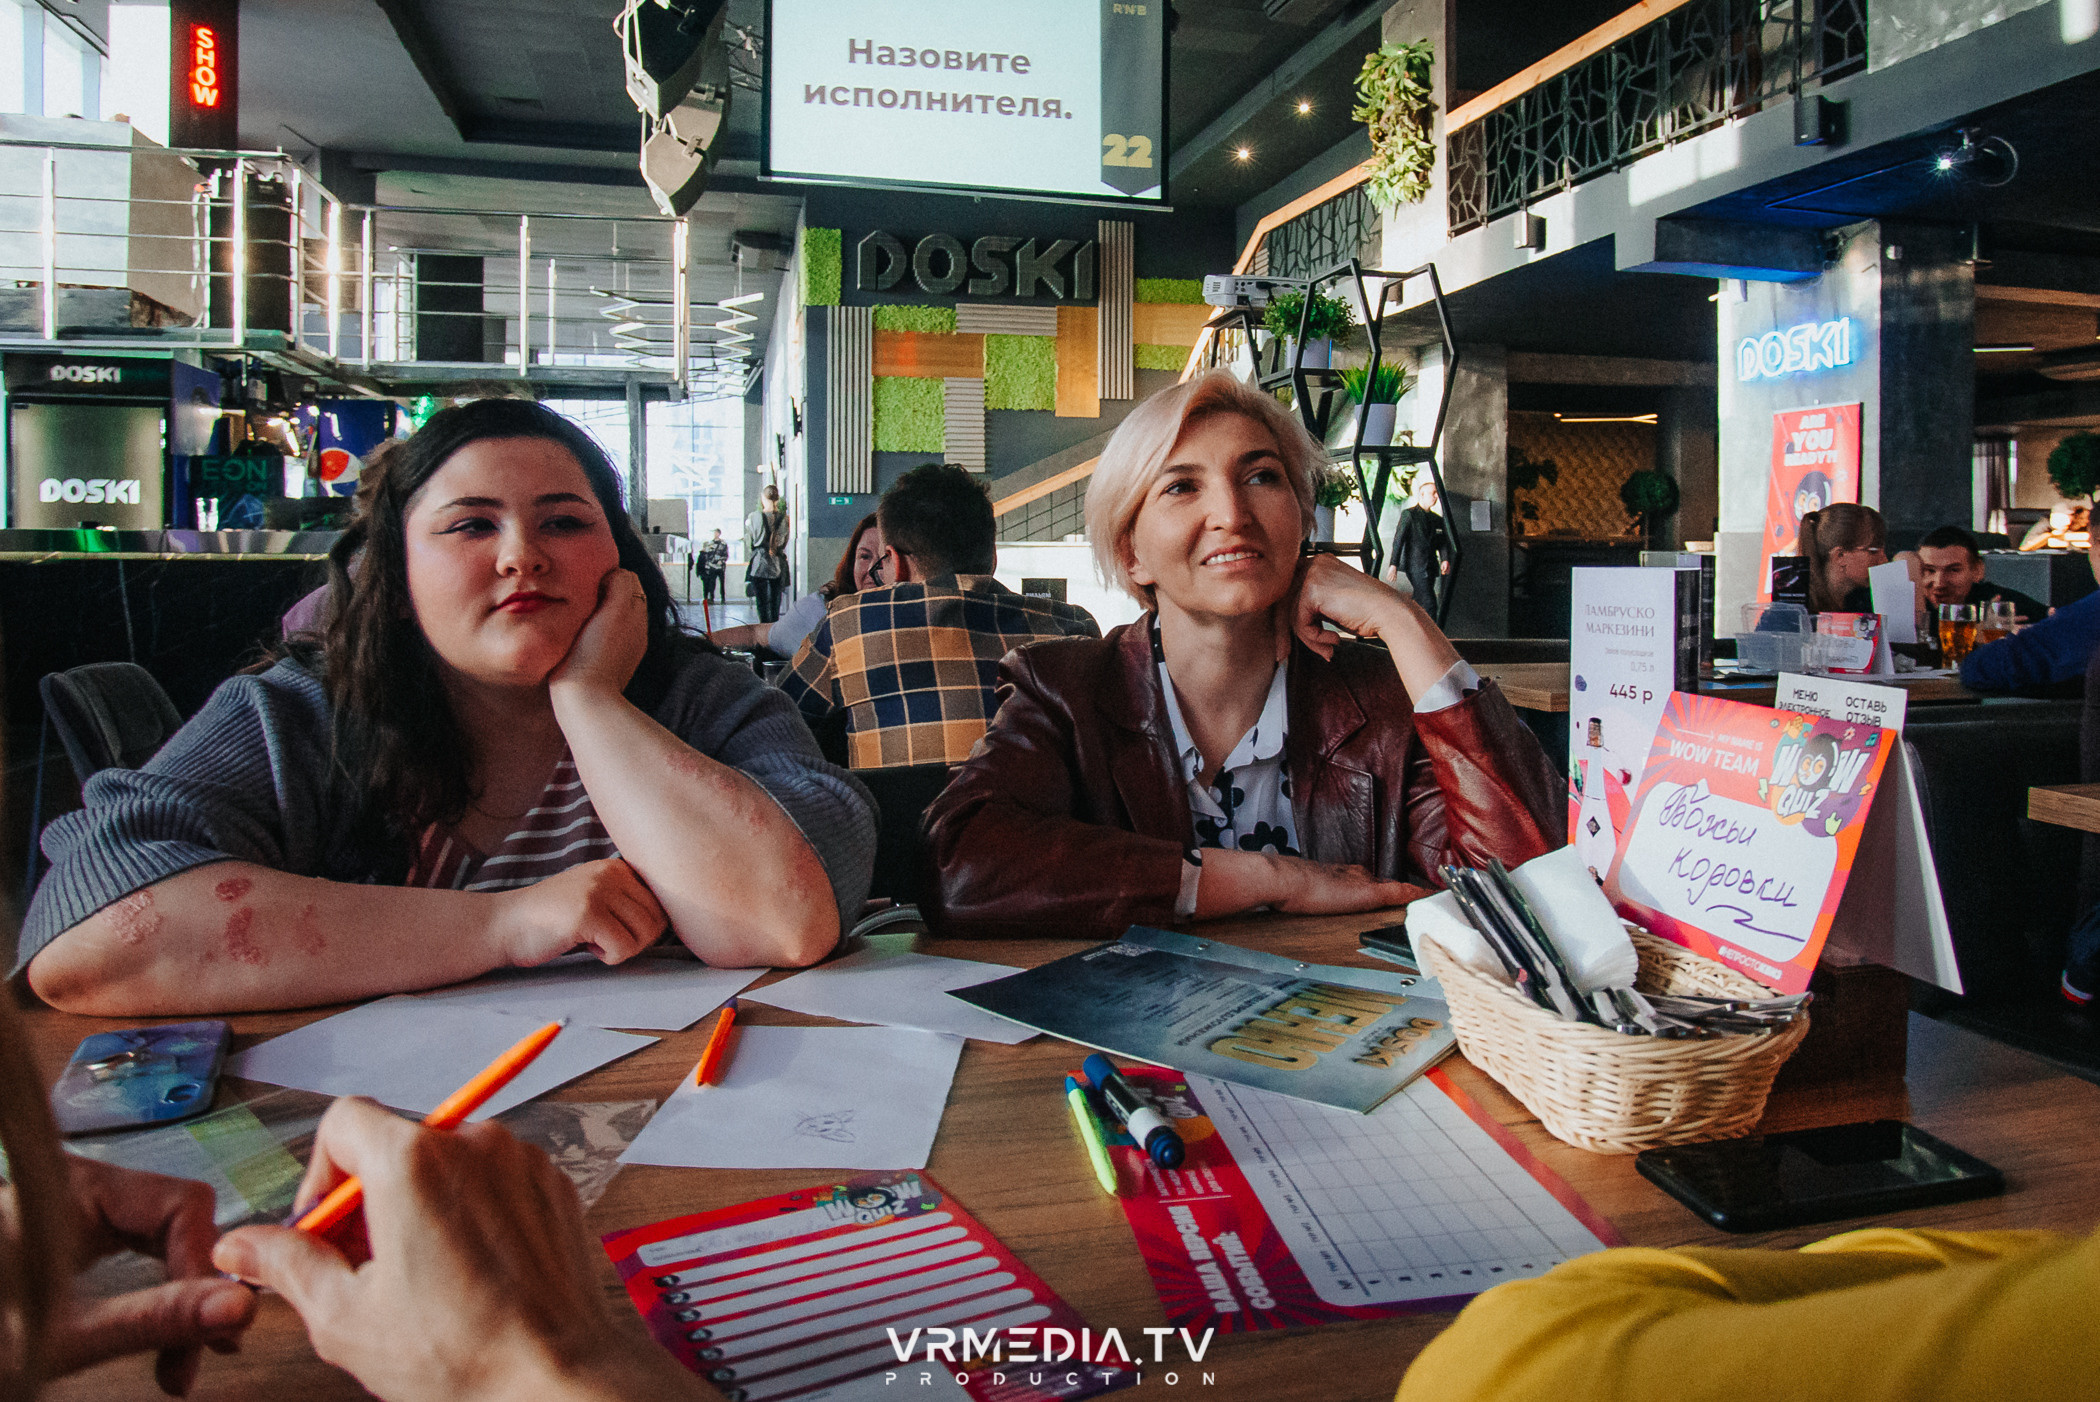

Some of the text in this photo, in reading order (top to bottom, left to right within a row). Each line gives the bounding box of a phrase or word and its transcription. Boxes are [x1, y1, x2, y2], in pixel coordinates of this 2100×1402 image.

[193, 26, 219, 106] SHOW
[848, 38, 1031, 74] Назовите
[804, 83, 1073, 119] исполнителя.
[1102, 133, 1153, 168] 22
[857, 229, 1094, 299] DOSKI
[1737, 316, 1850, 382] DOSKI
[50, 365, 122, 383] DOSKI
[1791, 428, 1834, 452] YOU
[39, 478, 141, 505] DOSKI
[1585, 604, 1655, 619] ЛАМБРУСКО
[1586, 622, 1655, 637] МАРКЕЗИНИ
[1609, 683, 1637, 700] 445
[1793, 688, 1819, 702] МЕНЮ
[1845, 696, 1888, 713] ОСТАВЬ
[1846, 711, 1882, 727] ОТЗЫВ
[1670, 739, 1760, 777] WOW TEAM
[1768, 738, 1871, 794] WOW
[1777, 783, 1832, 819] QUIZ
[855, 1199, 909, 1224] QUIZ
[1167, 1204, 1215, 1261] ВЕРСИЯ
[1195, 1260, 1240, 1313] ВАША
